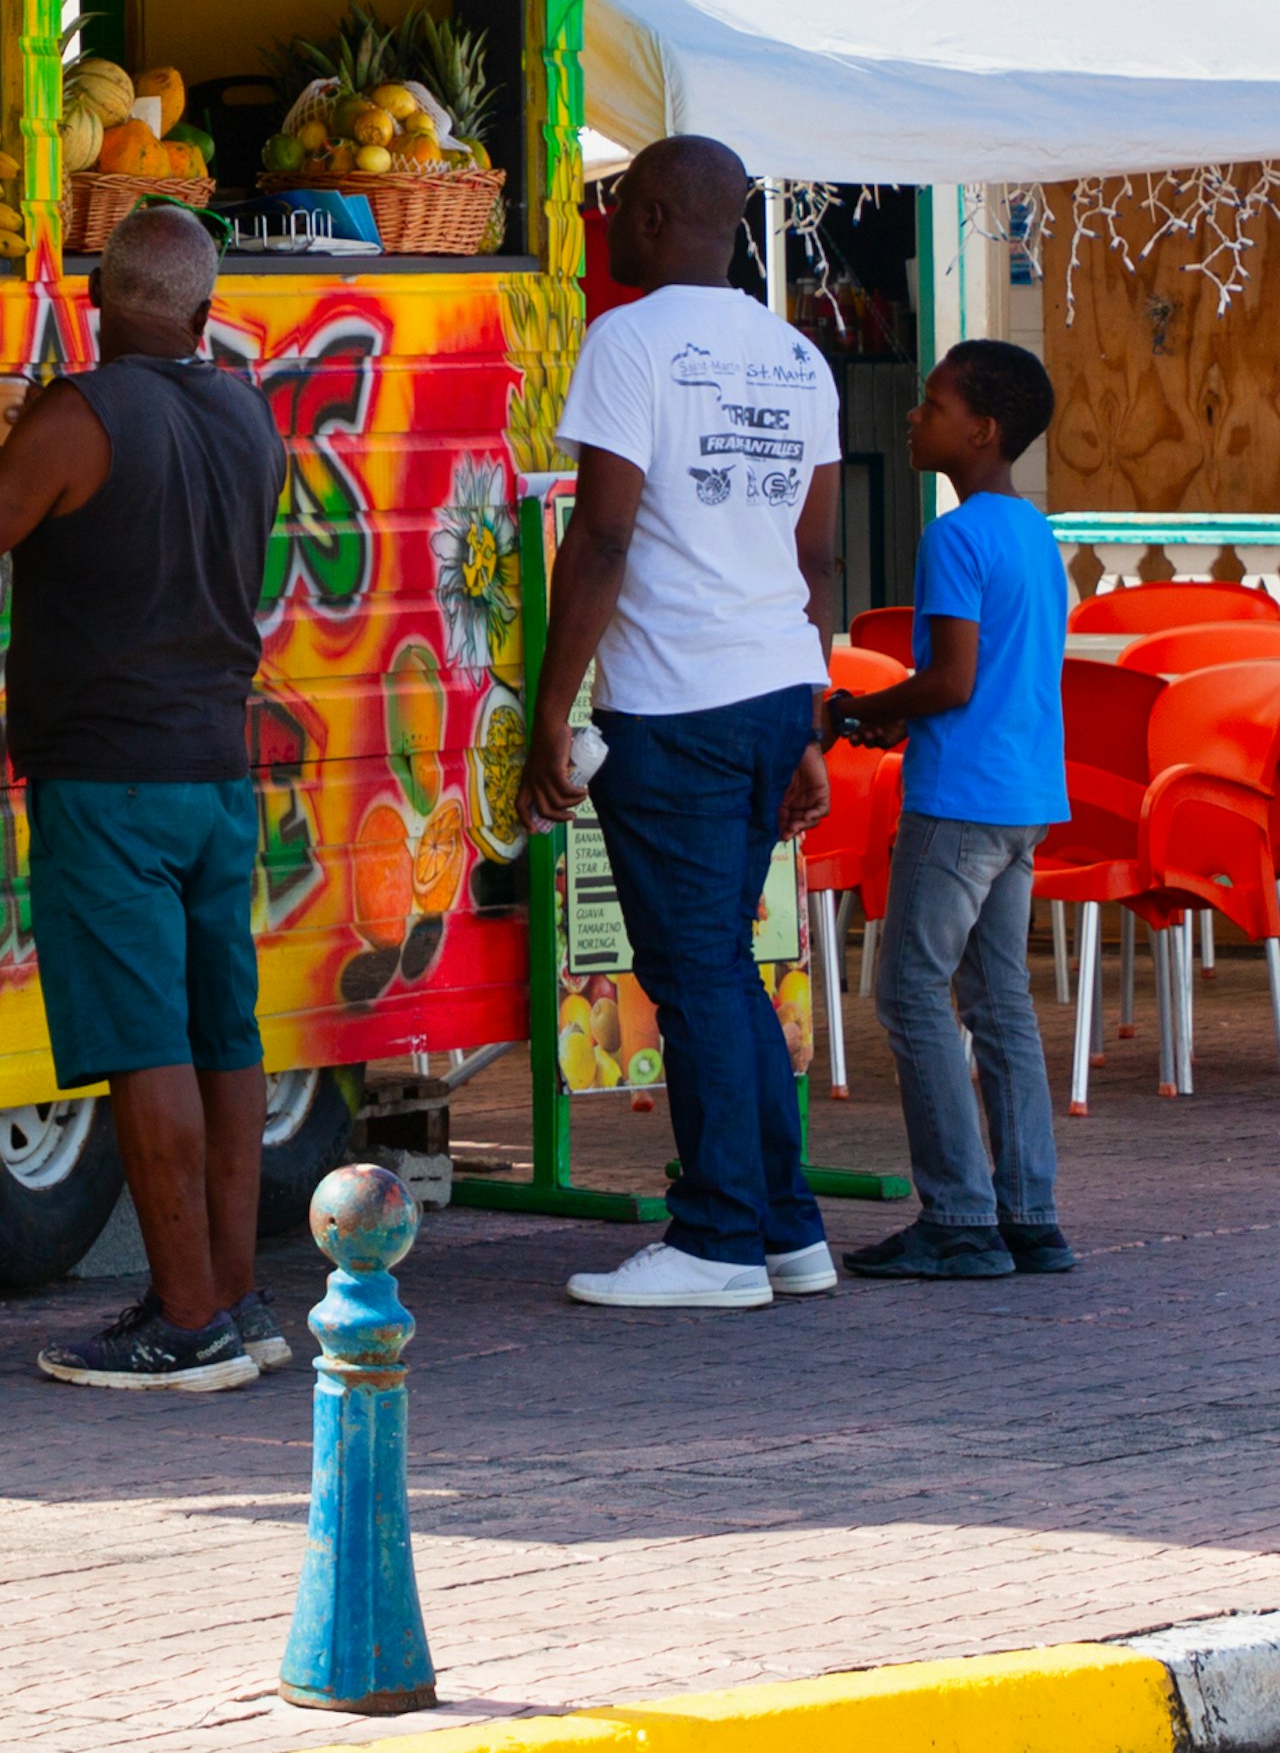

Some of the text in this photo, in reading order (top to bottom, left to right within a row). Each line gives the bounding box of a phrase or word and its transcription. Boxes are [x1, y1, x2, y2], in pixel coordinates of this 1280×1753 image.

[746, 363, 771, 379] St.
[772, 361, 817, 383] Martin
[721, 403, 790, 431] TRACE
[575, 863, 598, 875] STAR
[576, 908, 604, 920] GUAVA
[578, 921, 622, 935] TAMARIND
[578, 937, 616, 951] MORINGA
